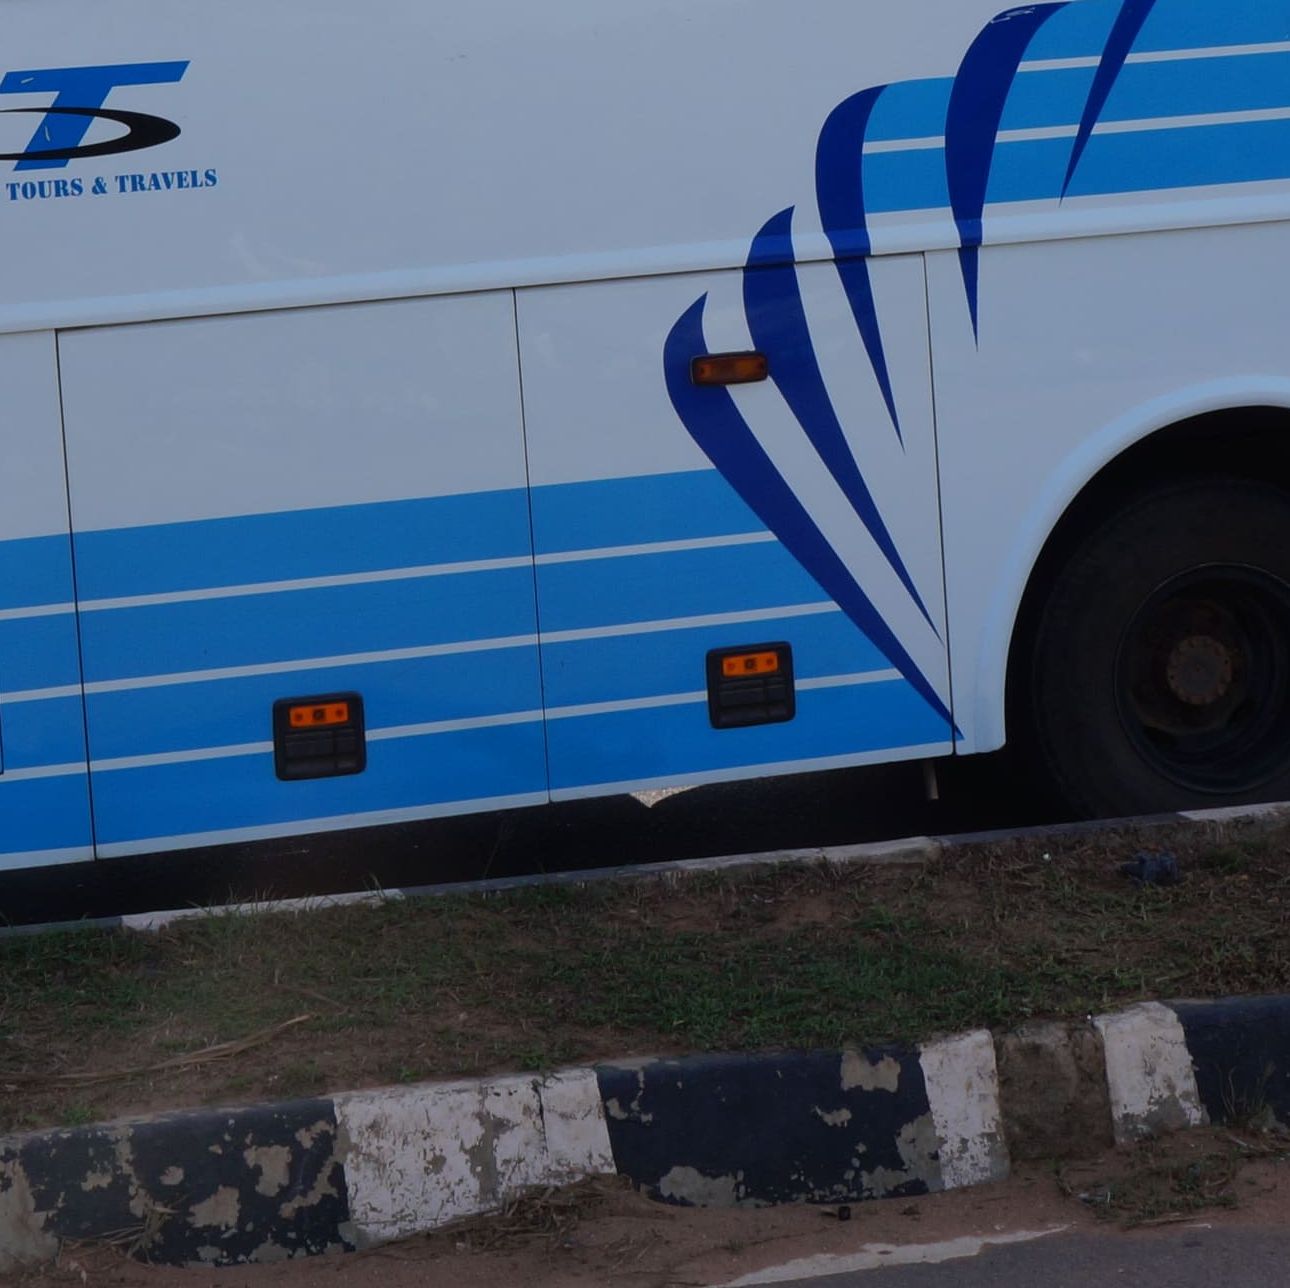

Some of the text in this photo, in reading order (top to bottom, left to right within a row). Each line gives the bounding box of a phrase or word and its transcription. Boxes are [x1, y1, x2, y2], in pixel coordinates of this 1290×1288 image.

[6, 178, 83, 200] TOURS
[91, 176, 108, 196] &
[115, 169, 217, 193] TRAVELS
